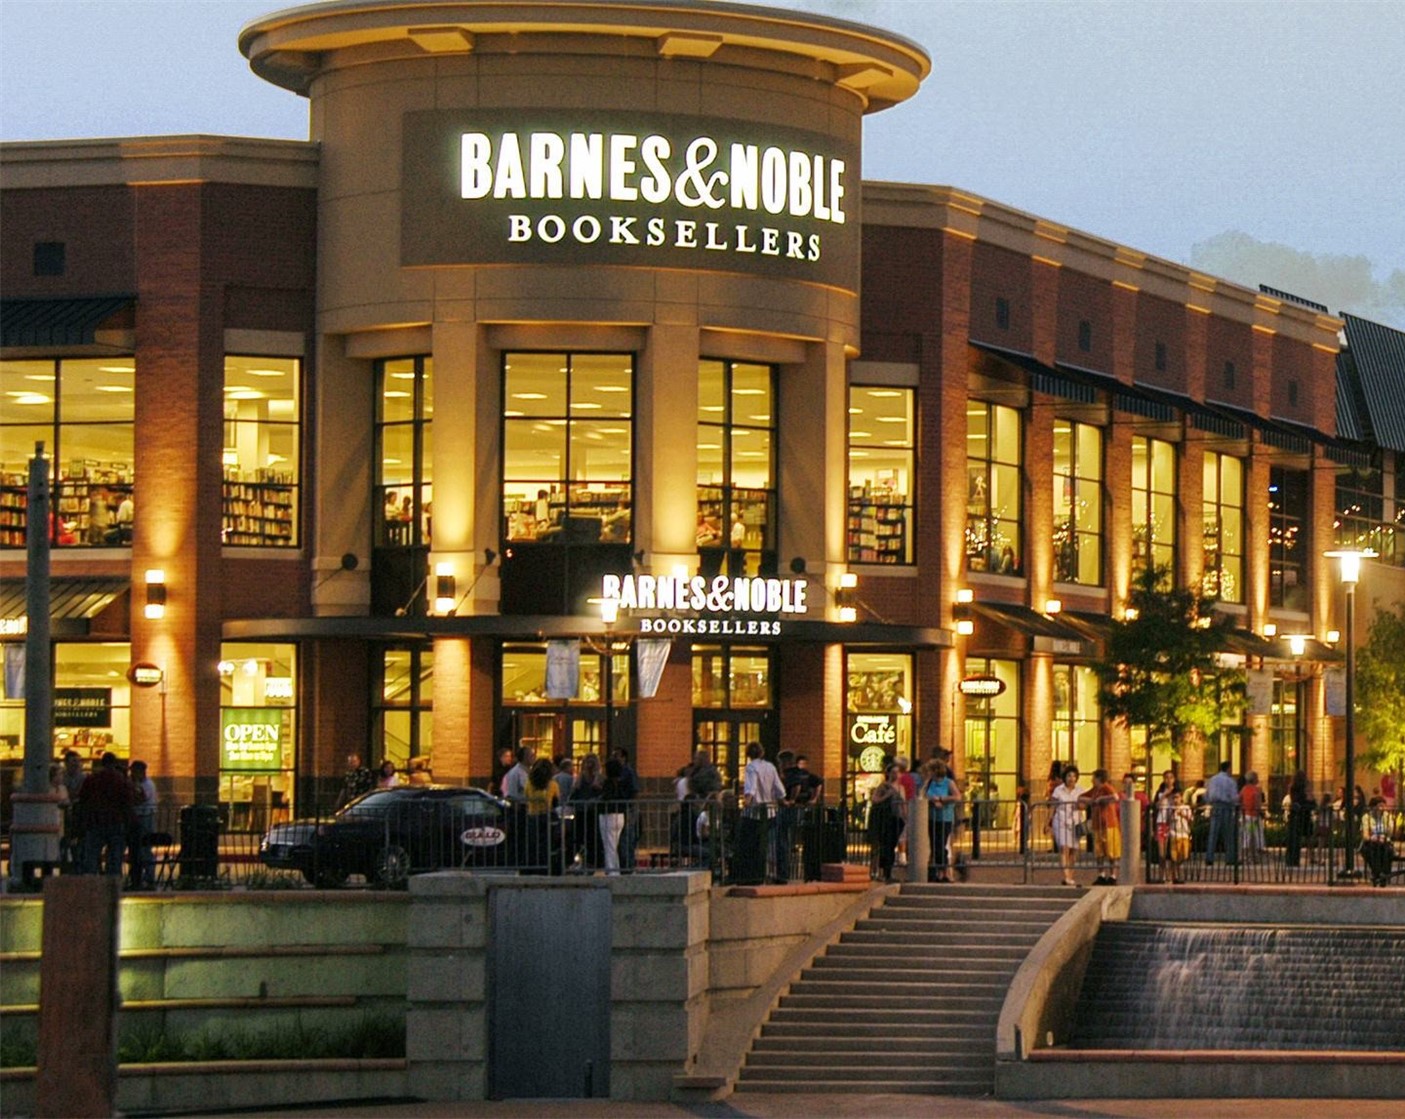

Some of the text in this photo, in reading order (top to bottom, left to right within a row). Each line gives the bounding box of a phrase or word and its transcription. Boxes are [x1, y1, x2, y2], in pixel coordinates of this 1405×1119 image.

[508, 214, 821, 262] BOOKSELLERS
[640, 619, 782, 636] BOOKSELLERS
[224, 724, 280, 741] OPEN
[851, 722, 895, 744] Café
